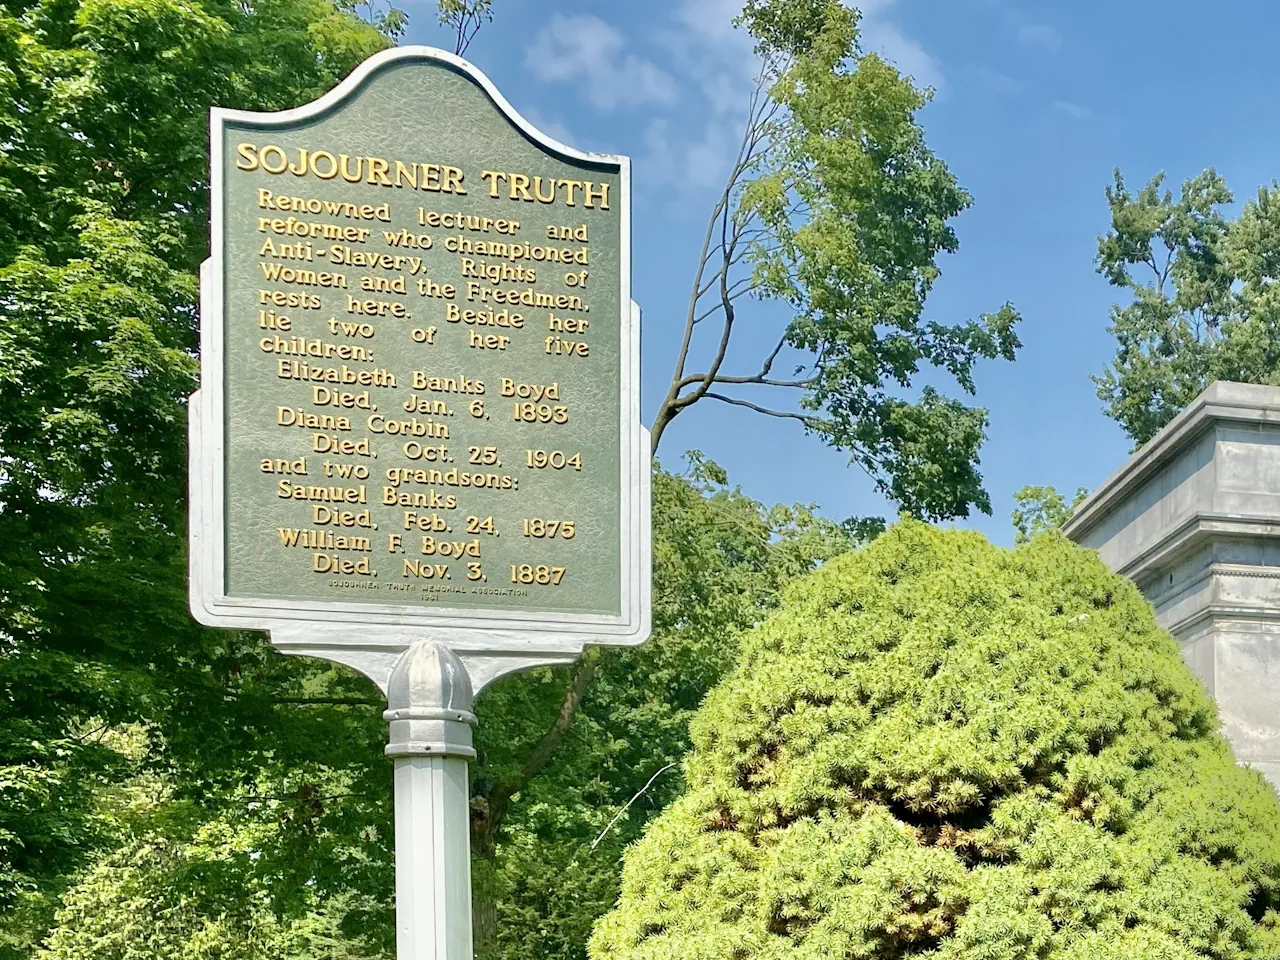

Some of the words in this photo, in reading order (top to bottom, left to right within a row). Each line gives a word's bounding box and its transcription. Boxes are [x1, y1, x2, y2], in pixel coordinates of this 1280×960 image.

[236, 143, 467, 195] SOJOURNER
[481, 170, 610, 210] TRUTH
[258, 188, 391, 222] Renowned
[417, 207, 520, 236] lecturer
[546, 224, 589, 242] and
[258, 216, 370, 244] reformer
[382, 229, 432, 250] who
[444, 234, 589, 265] championed
[259, 237, 427, 275] Anti-Slavery,
[461, 257, 536, 284] Rights
[564, 270, 588, 288] of
[260, 262, 347, 288] Women
[361, 275, 406, 295] and
[416, 278, 455, 298] the
[466, 281, 590, 312] Freedmen,
[259, 289, 321, 310] rests
[347, 294, 412, 319] here.
[445, 302, 524, 328] Beside
[548, 313, 588, 333] her
[259, 309, 291, 331] lie
[327, 316, 374, 338] two
[411, 325, 437, 344] of
[469, 329, 510, 350] her
[544, 336, 589, 357] five
[259, 335, 374, 362] children:
[277, 359, 397, 388] Elizabeth
[411, 370, 485, 394] Banks
[500, 377, 560, 403] Boyd
[276, 405, 351, 431] Diana
[367, 414, 450, 438] Corbin
[312, 385, 378, 412] Died,
[403, 394, 454, 416] Jan.
[469, 399, 490, 420] 6,
[513, 402, 569, 424] 1893
[312, 432, 378, 459] Died,
[403, 441, 454, 462] Oct.
[468, 446, 502, 467] 25,
[526, 449, 582, 472] 1904
[260, 456, 308, 475] and
[323, 459, 369, 480] two
[386, 467, 519, 491] grandsons:
[277, 479, 367, 504] Samuel
[382, 486, 456, 509] Banks
[312, 504, 378, 530] Died,
[403, 511, 452, 532] Feb.
[466, 515, 500, 537] 24,
[523, 518, 576, 539] 1875
[277, 527, 372, 551] William
[388, 533, 405, 553] F.
[421, 535, 480, 560] Boyd
[312, 552, 378, 577] Died,
[402, 559, 451, 580] Nov.
[467, 562, 487, 583] 3,
[511, 564, 566, 585] 1887
[328, 580, 380, 590] SOJOURNER
[386, 583, 416, 592] TRUTH
[422, 583, 467, 594] MEMORIAL
[471, 586, 528, 597] ASSOCIATION
